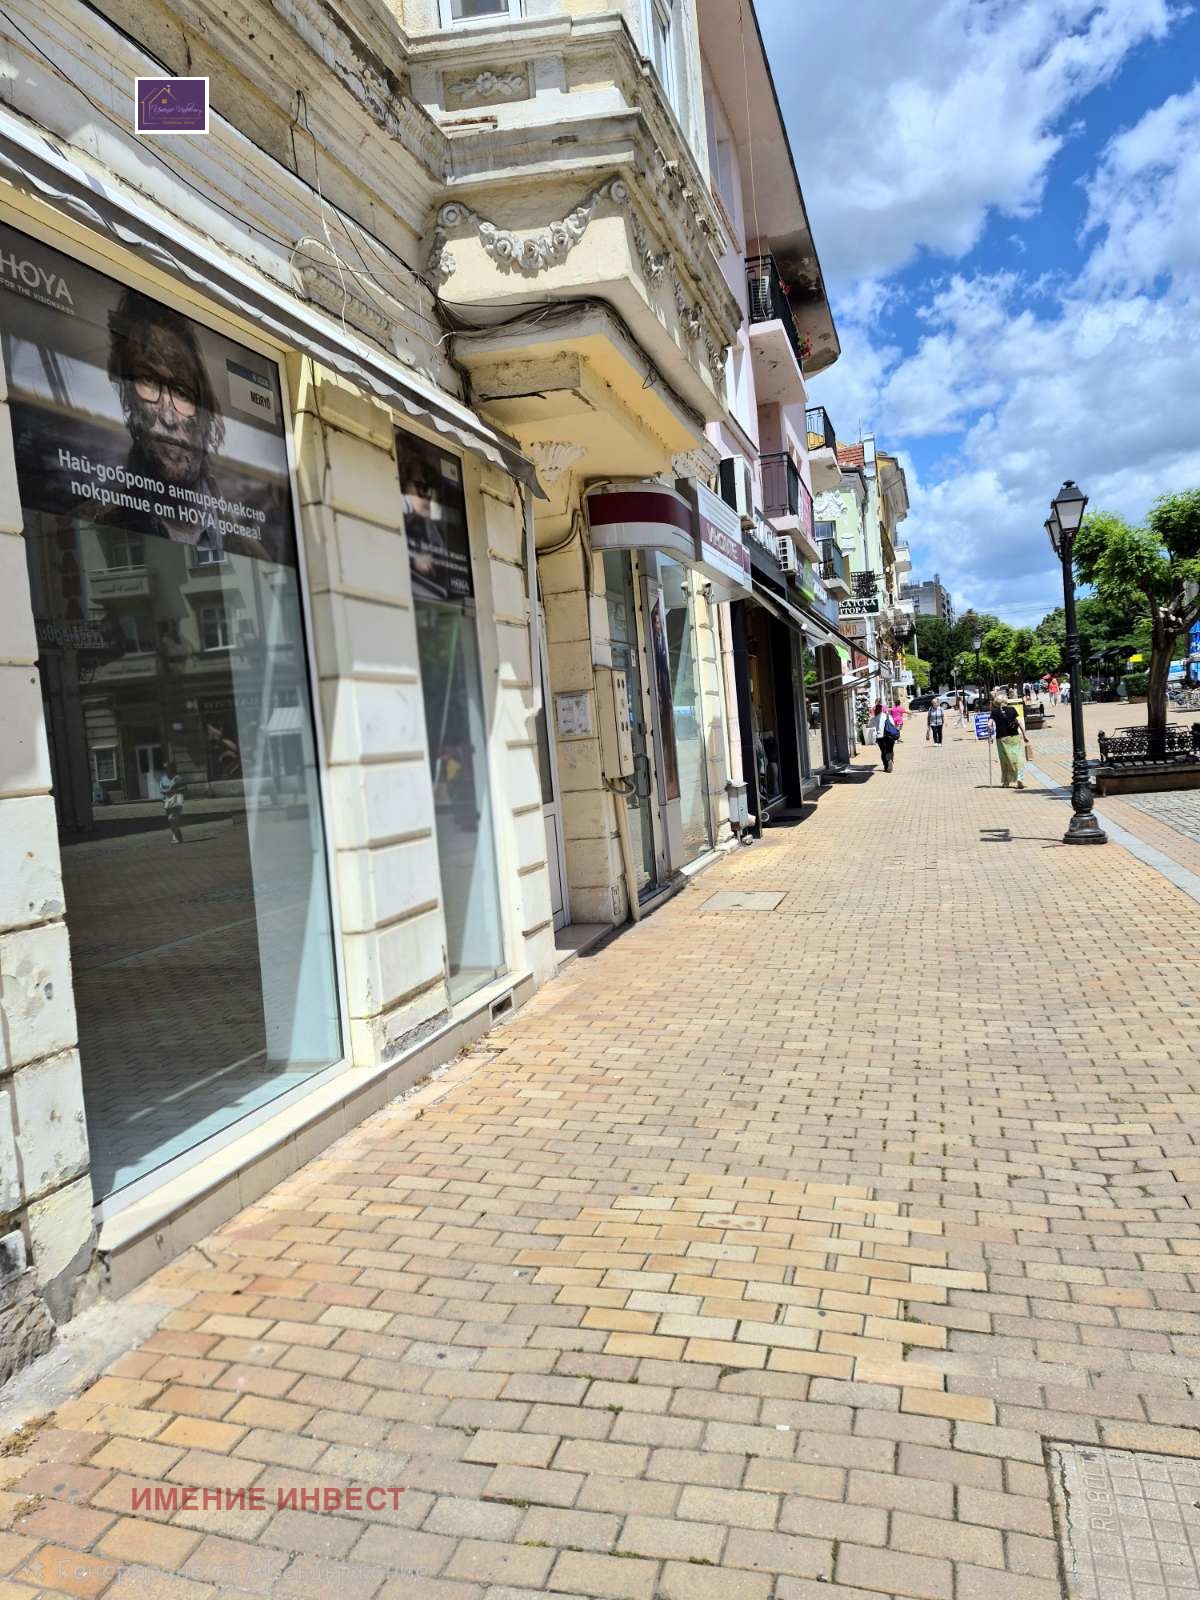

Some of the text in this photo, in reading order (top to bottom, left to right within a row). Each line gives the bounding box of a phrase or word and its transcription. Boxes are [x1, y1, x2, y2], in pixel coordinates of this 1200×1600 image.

[0, 249, 74, 305] HOYA
[58, 448, 266, 523] Най-доброто антирефлексно
[71, 481, 262, 541] покритие от HOYA досега!
